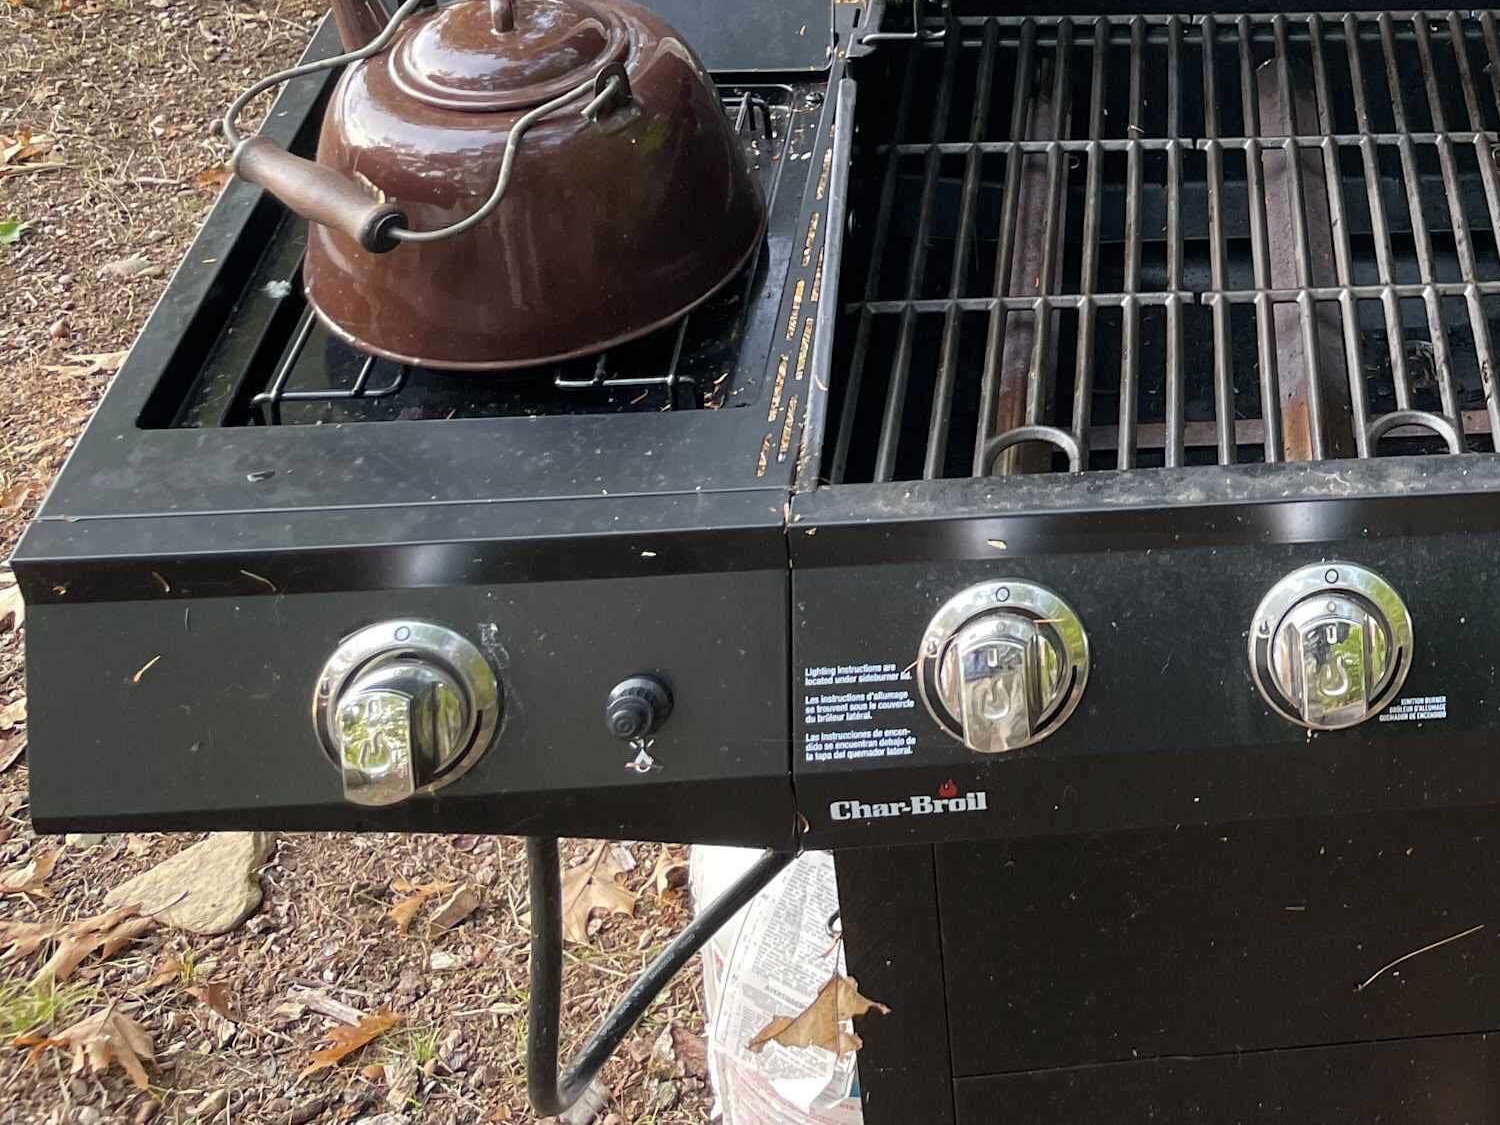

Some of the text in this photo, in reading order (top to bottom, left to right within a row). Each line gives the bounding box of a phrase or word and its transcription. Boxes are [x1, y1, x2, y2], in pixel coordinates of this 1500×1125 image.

[805, 666, 836, 677] Lighting
[838, 665, 881, 674] instructions
[805, 677, 833, 685] located
[835, 675, 857, 683] under
[858, 673, 899, 683] sideburner
[805, 691, 908, 704] Les instructions d'allumage
[817, 703, 848, 712] trouvent
[869, 702, 876, 710] le
[878, 699, 915, 709] couvercle
[805, 715, 816, 723] du
[806, 734, 820, 742] Las
[821, 730, 871, 741] instrucciones
[873, 729, 883, 737] de
[806, 742, 823, 751] dido
[835, 740, 878, 749] encuentran
[879, 738, 905, 747] debajo
[906, 737, 916, 745] de
[806, 746, 913, 761] la tapa del quemador lateral.
[830, 792, 987, 820] Char-Broil
